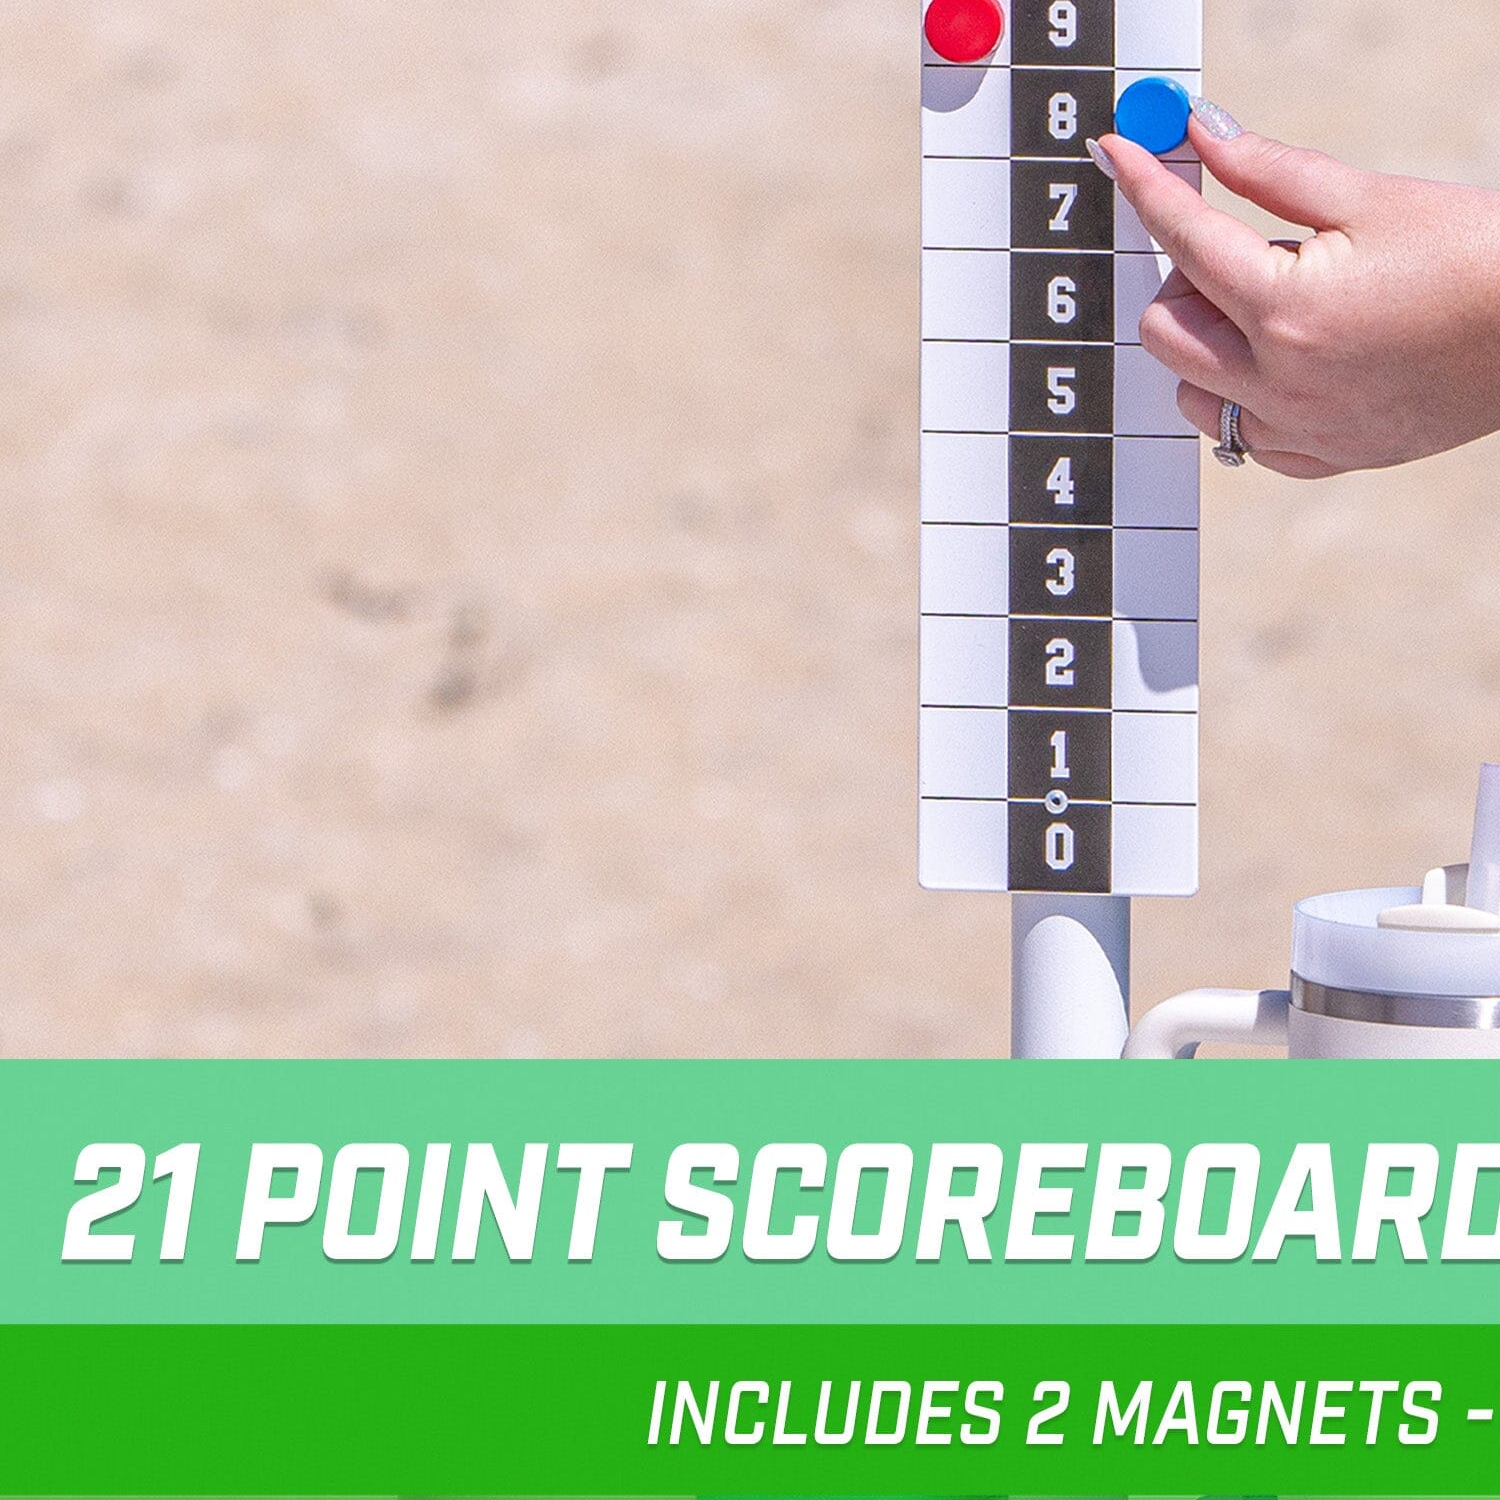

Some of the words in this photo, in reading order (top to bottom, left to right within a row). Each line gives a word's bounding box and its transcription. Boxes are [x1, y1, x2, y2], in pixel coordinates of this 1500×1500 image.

[1047, 0, 1077, 48] 9
[1048, 92, 1078, 140] 8
[1048, 182, 1078, 232] 7
[1046, 275, 1077, 324] 6
[1046, 366, 1076, 415] 5
[1045, 456, 1075, 505] 4
[1045, 547, 1075, 596] 3
[1044, 637, 1075, 686] 2
[1050, 730, 1071, 779] 1
[1045, 822, 1075, 871] 0
